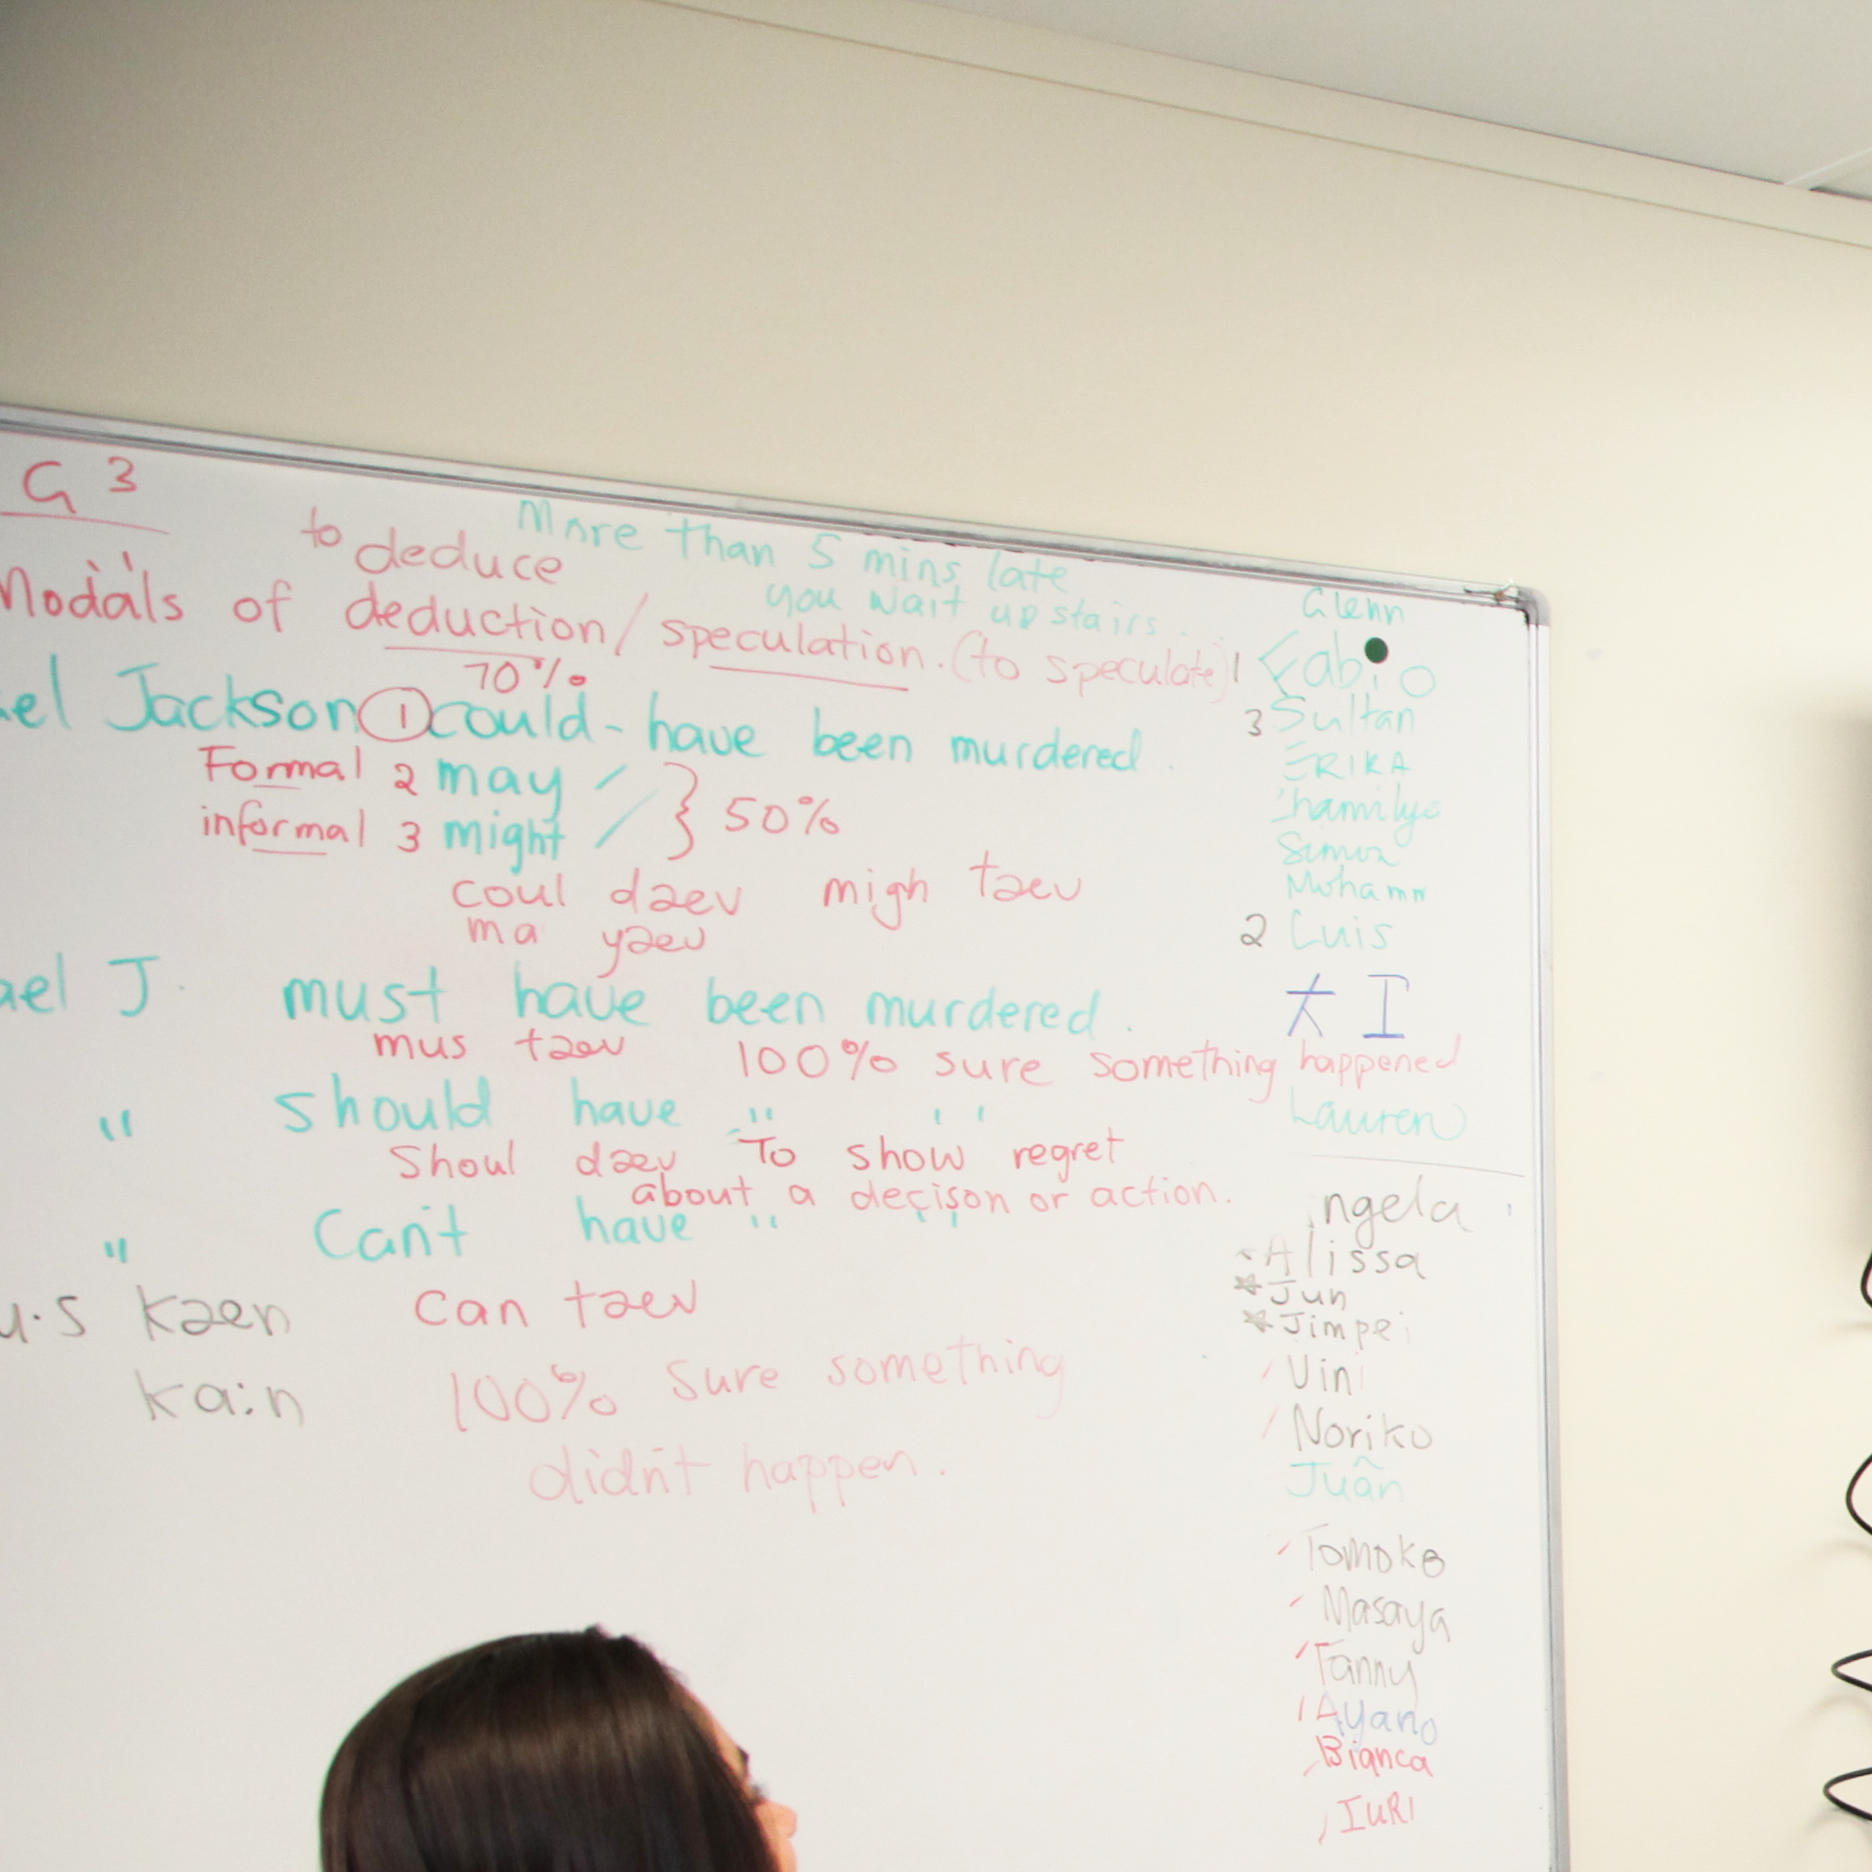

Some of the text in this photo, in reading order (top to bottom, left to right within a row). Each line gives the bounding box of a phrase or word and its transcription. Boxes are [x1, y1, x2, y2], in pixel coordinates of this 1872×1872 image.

[300, 506, 564, 584] to deduce
[665, 518, 775, 568] than
[808, 532, 843, 570] 5
[864, 547, 961, 587] mins
[987, 549, 1069, 593] late
[233, 579, 292, 633] of
[104, 663, 360, 733] Jackson
[428, 685, 592, 743] could
[648, 692, 766, 759] have
[812, 708, 913, 765] been
[1244, 693, 1415, 736] 3 Sultan
[198, 744, 564, 818] Formal 2 may
[202, 798, 566, 874] informal 3 might
[724, 796, 840, 836] 50%
[823, 870, 930, 931] migh
[1240, 913, 1267, 948] 2
[283, 966, 447, 1024] must
[513, 960, 651, 1026] have
[706, 977, 825, 1028] been
[373, 1032, 467, 1062] mus
[737, 1038, 898, 1082] 100%
[935, 1045, 1054, 1088] sure
[1088, 1039, 1277, 1104] something
[1301, 1033, 1462, 1090] happened
[572, 1075, 680, 1129] have
[846, 1135, 966, 1173] show
[1012, 1126, 1126, 1183] regret
[575, 1195, 694, 1246] have
[631, 1174, 754, 1207] about
[789, 1184, 817, 1208] a
[1029, 1190, 1071, 1213] or
[450, 1362, 618, 1432] 100%
[826, 1336, 1065, 1421] something
[1292, 1402, 1434, 1452] Noriko
[1323, 1584, 1451, 1655] Masaya
